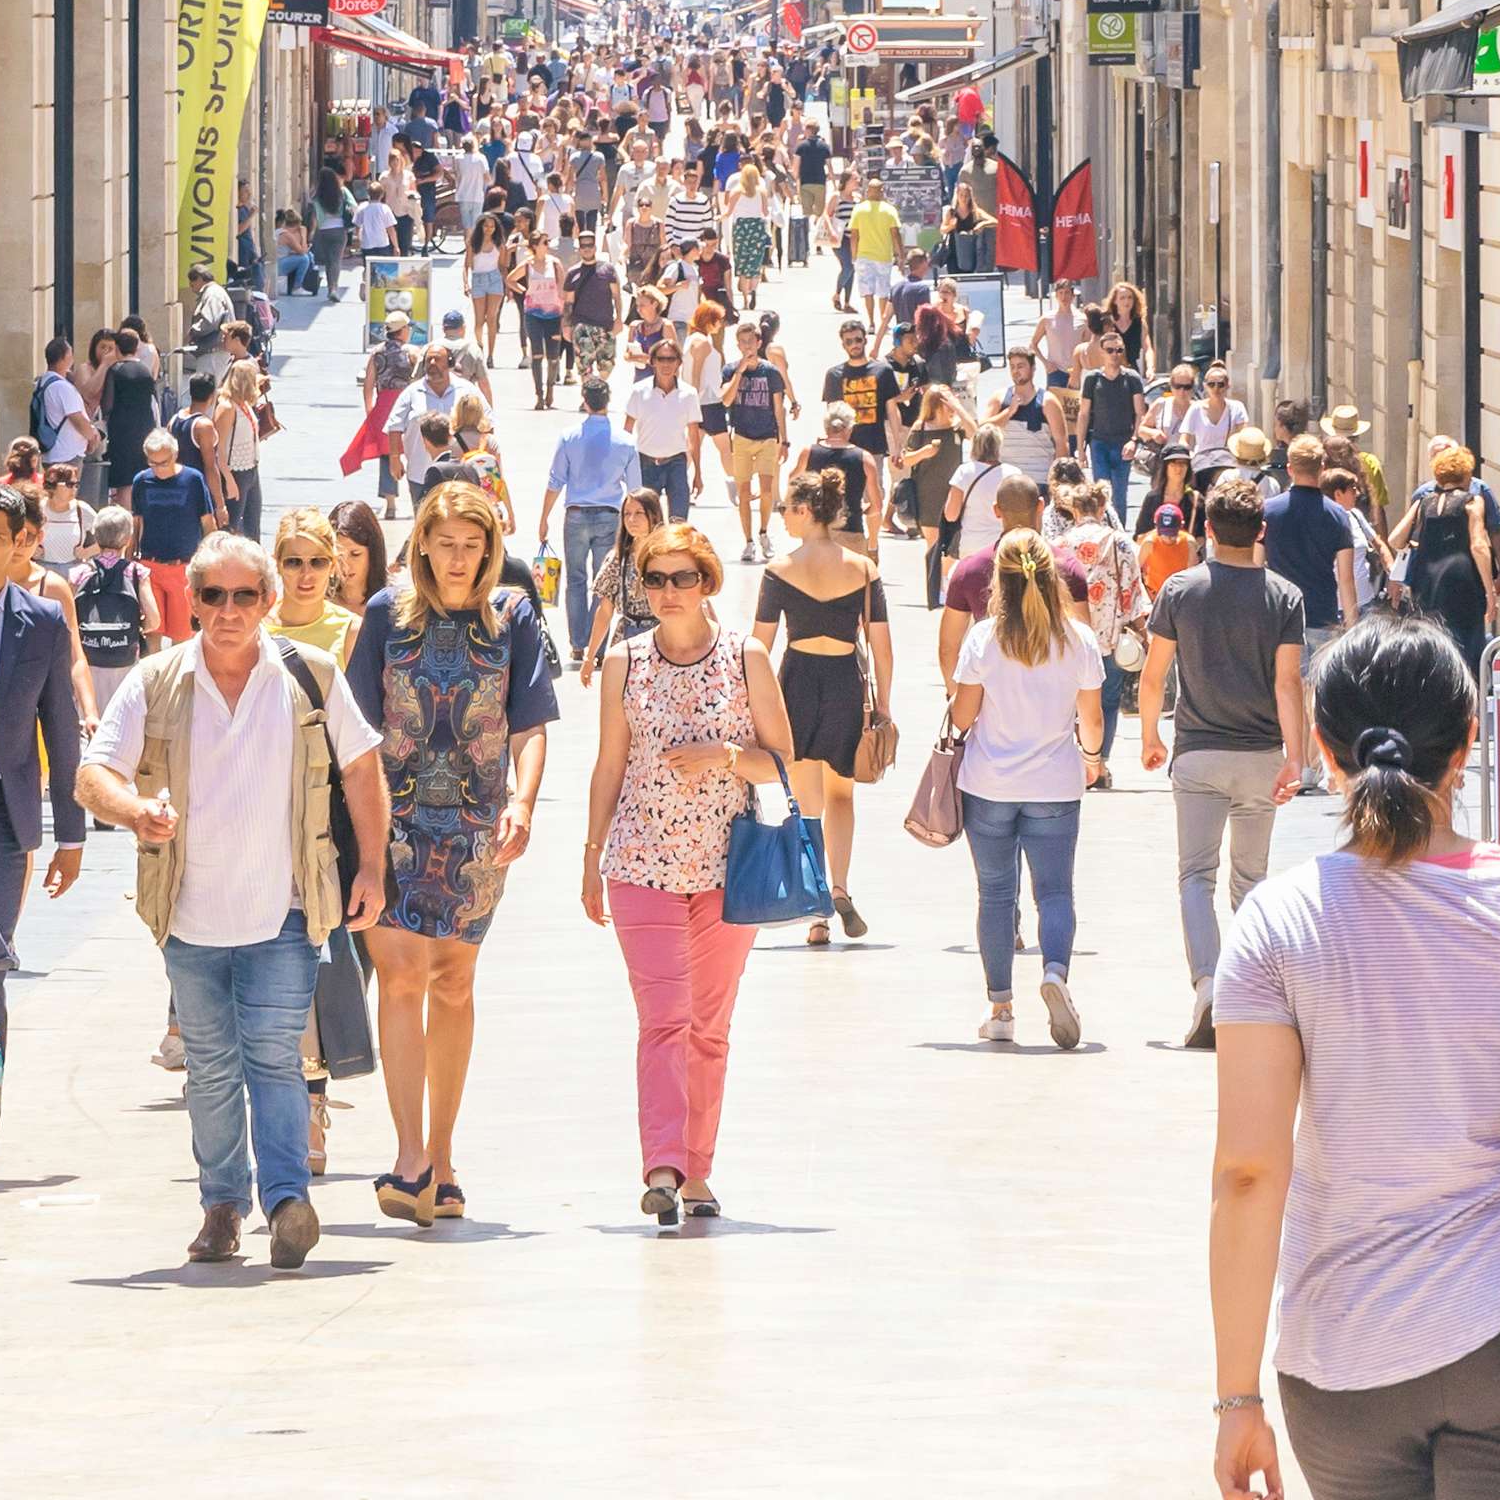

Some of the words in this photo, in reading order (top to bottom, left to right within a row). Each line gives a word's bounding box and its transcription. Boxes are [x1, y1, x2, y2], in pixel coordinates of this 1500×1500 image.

[266, 10, 323, 24] COURIR
[999, 203, 1033, 219] HEMA
[1055, 211, 1093, 229] HEMA
